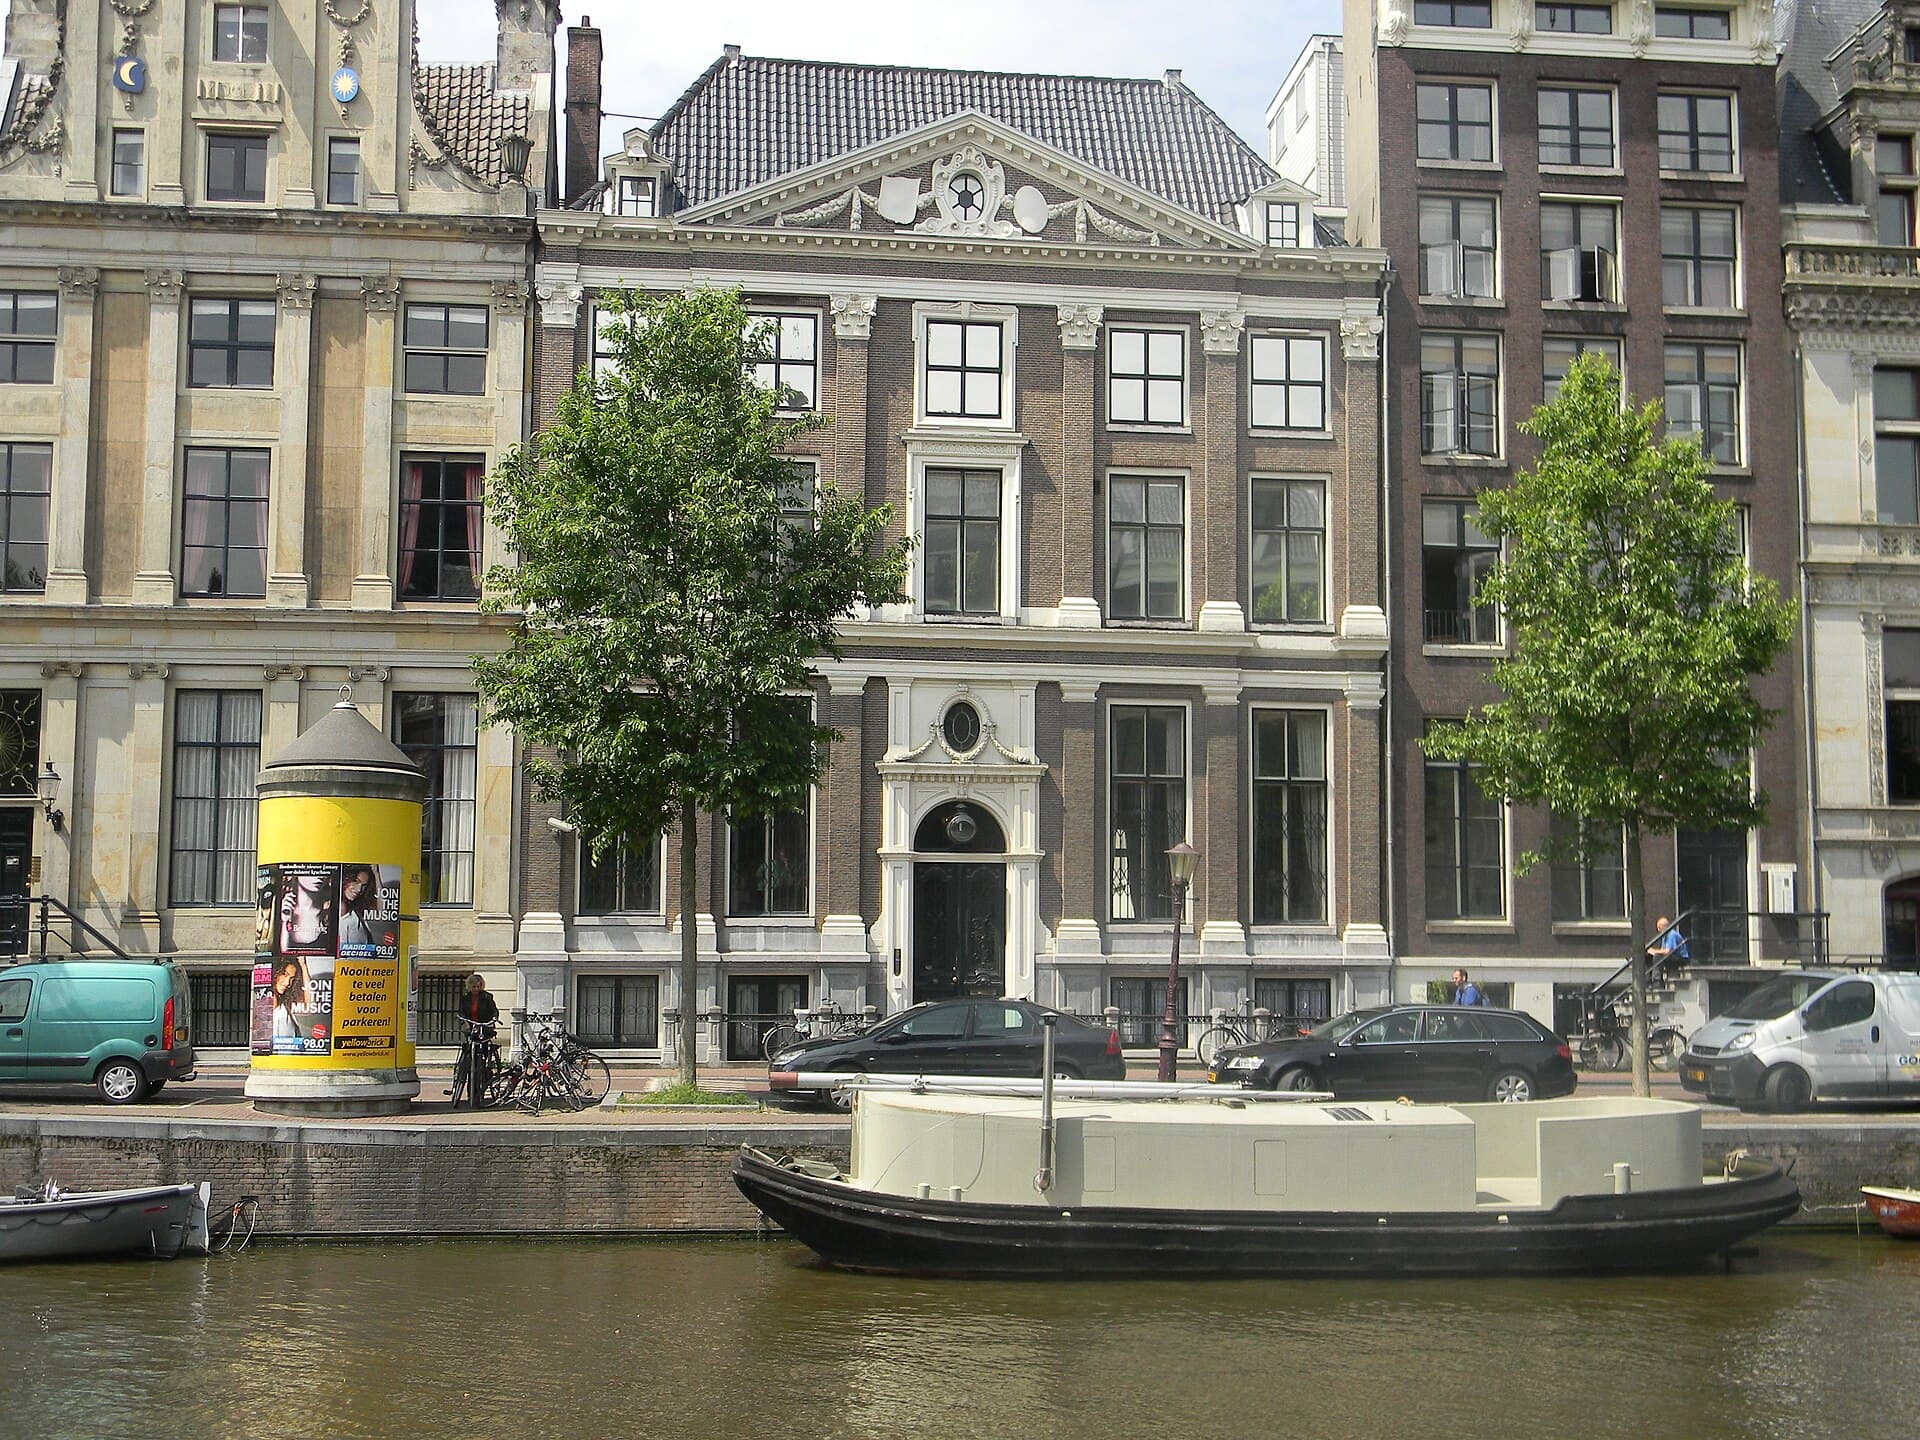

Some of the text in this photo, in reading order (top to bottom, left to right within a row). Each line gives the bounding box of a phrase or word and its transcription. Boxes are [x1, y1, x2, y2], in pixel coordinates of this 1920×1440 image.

[374, 888, 399, 899] JOIN
[383, 899, 398, 910] THE
[363, 909, 398, 921] MUSIC
[340, 966, 394, 976] Nooit meer
[301, 980, 332, 991] JOIN
[352, 979, 385, 989] te veel
[310, 991, 332, 1002] THE
[349, 992, 387, 1001] betalen
[291, 1002, 332, 1014] MUSIC
[357, 1006, 380, 1014] voor
[342, 1017, 391, 1029] parkeren!
[1898, 1055, 1920, 1066] GO
